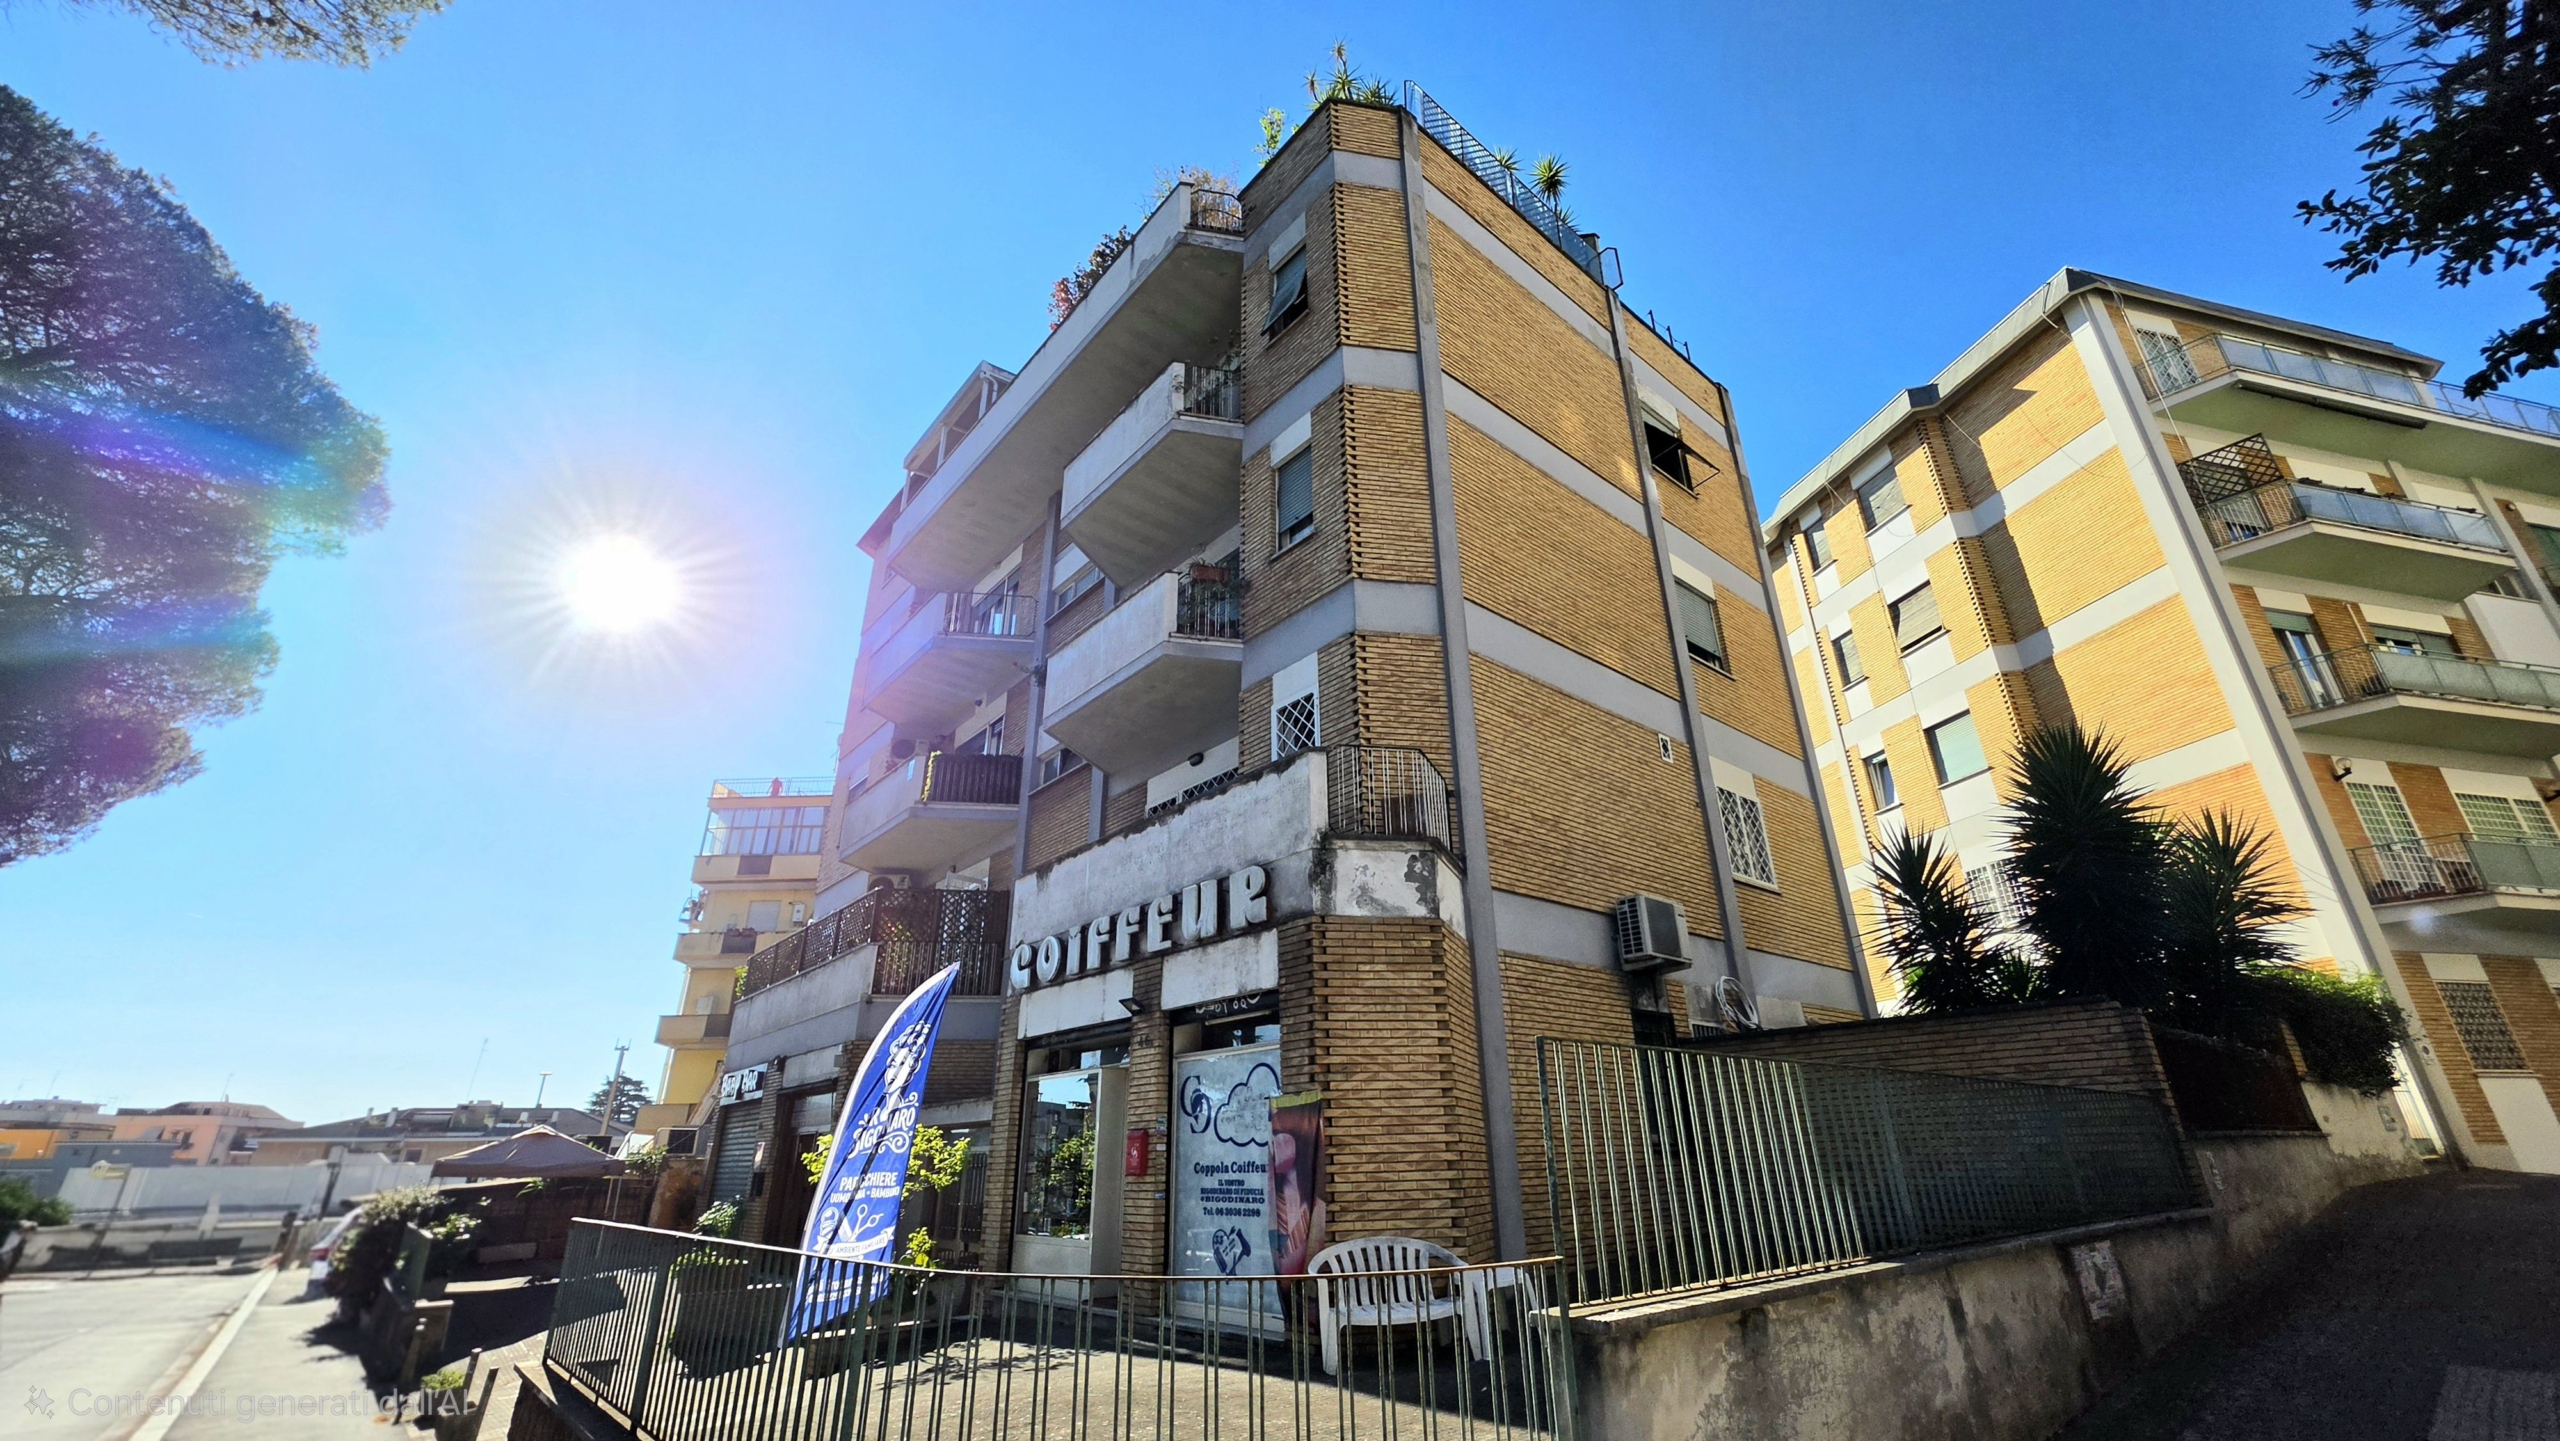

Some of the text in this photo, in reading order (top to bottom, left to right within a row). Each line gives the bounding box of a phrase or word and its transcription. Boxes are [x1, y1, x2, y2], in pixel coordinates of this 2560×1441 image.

[1010, 865, 1270, 989] COIFFEUR
[741, 1070, 758, 1093] BAR
[1194, 1161, 1229, 1177] Coppola
[1240, 1188, 1264, 1196] FIDUCIA
